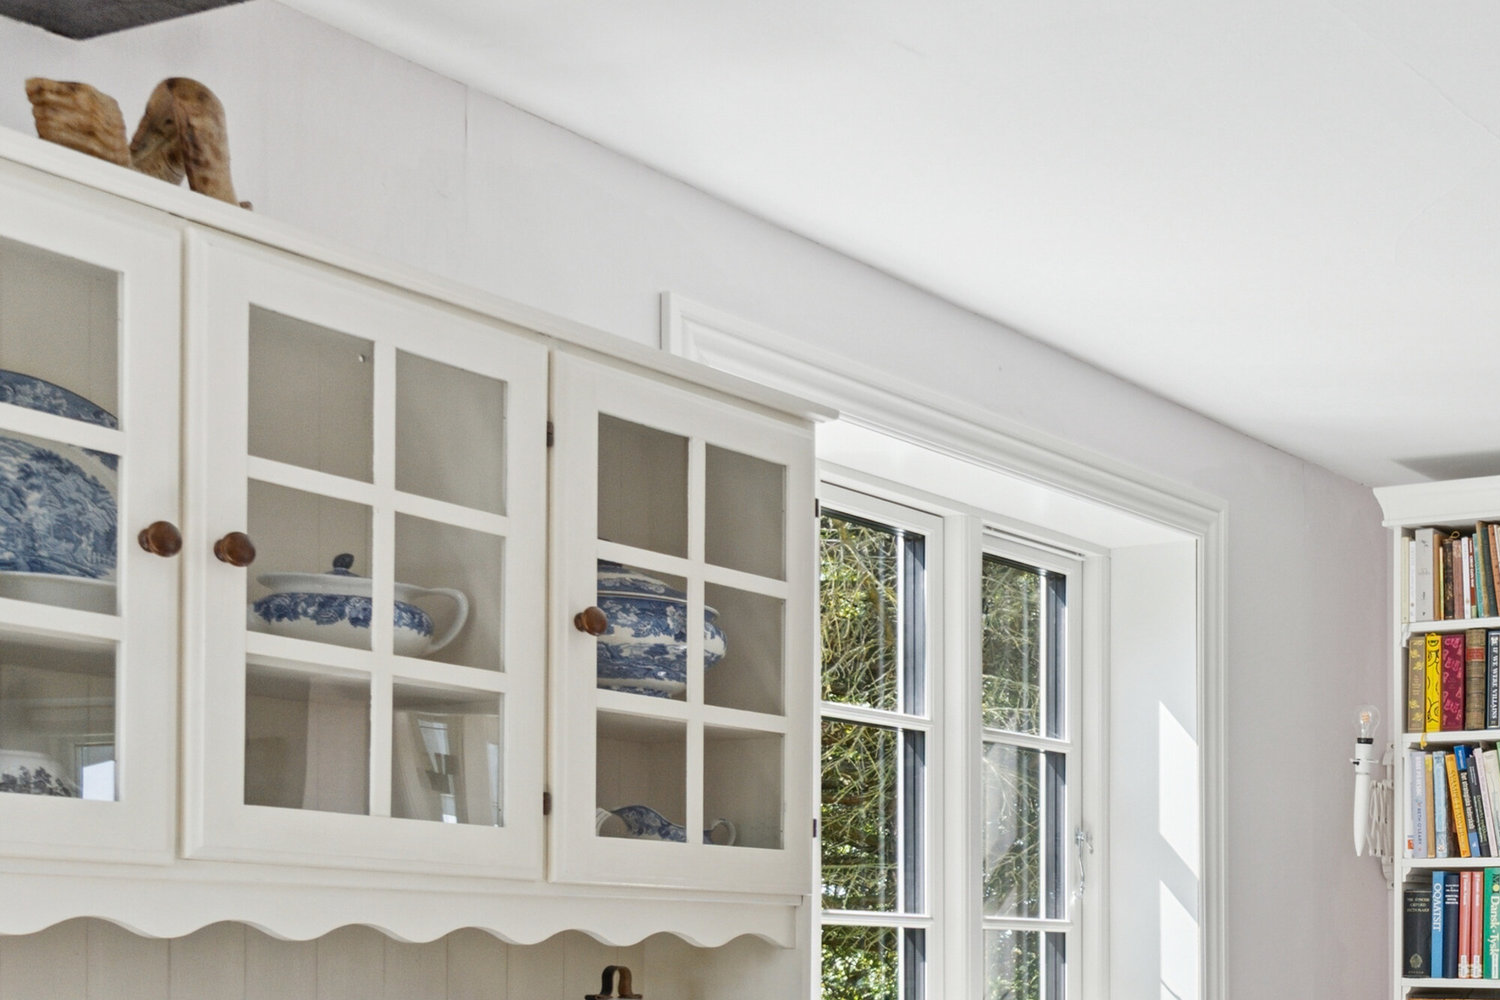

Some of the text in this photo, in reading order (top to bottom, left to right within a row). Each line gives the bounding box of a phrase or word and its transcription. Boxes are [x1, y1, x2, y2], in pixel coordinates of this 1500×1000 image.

[1432, 883, 1442, 932] OQAATSIT
[1488, 896, 1500, 956] Dansk Tysk
